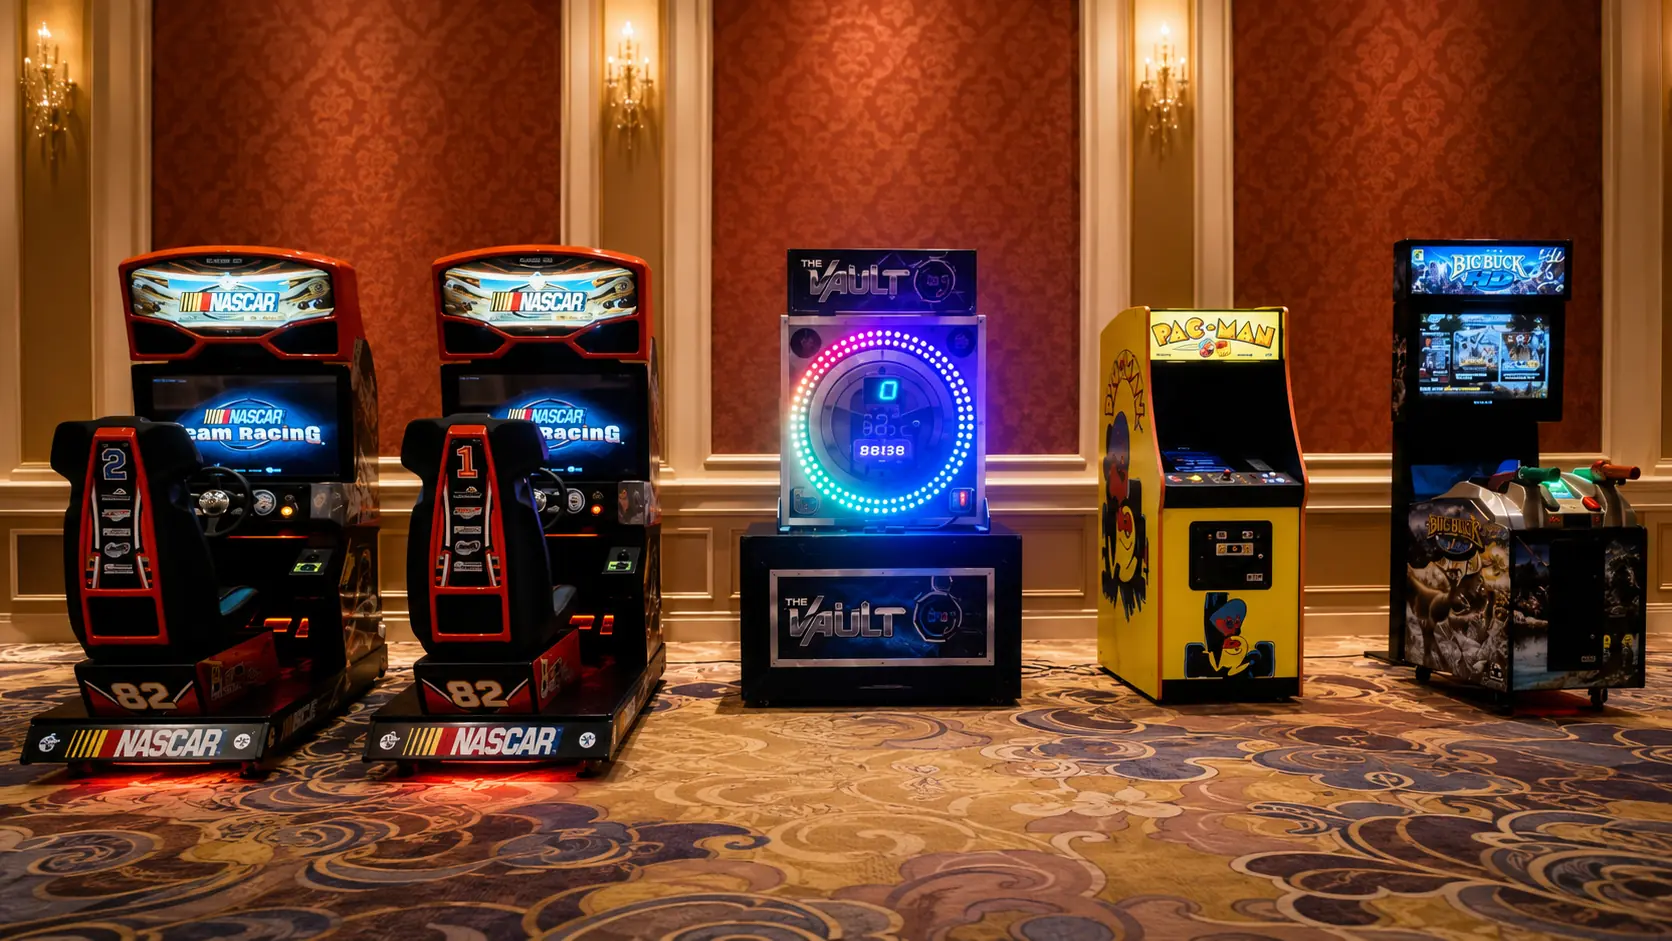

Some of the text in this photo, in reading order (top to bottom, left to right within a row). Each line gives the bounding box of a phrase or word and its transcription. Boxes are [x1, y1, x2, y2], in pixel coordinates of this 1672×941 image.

[801, 259, 822, 268] THE
[1450, 254, 1481, 281] BIG
[1483, 254, 1529, 278] BUCK
[808, 259, 911, 303] VAULT
[209, 292, 276, 312] NASCAR
[519, 292, 584, 312] NASCAR
[879, 381, 898, 400] 0
[228, 409, 283, 425] NASCAR
[531, 409, 584, 424] NASCAR
[186, 427, 232, 441] eam
[102, 448, 127, 480] 2
[457, 445, 478, 478] 1
[785, 598, 808, 606] THE
[788, 595, 906, 647] VAULT
[111, 682, 177, 710] 82
[446, 680, 509, 708] 82
[113, 728, 223, 758] NASCAR
[450, 726, 557, 756] NASCAR
